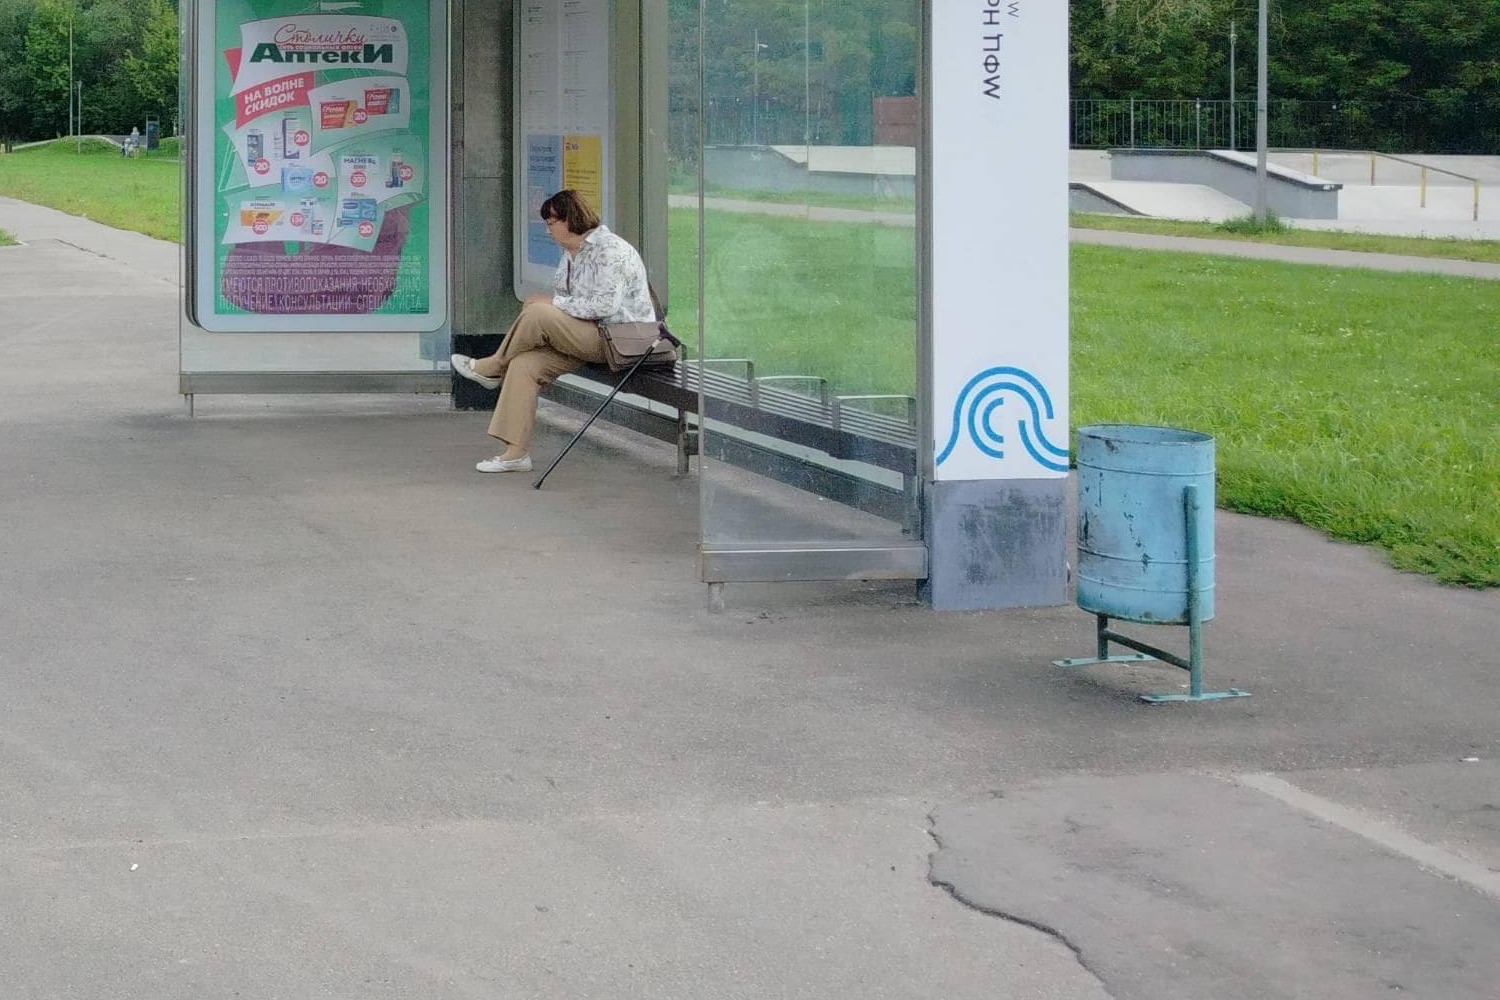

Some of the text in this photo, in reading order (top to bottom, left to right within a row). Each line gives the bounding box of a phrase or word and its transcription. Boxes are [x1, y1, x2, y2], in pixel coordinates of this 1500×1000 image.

[274, 23, 365, 45] Столички
[983, 33, 1003, 99] МФЦ
[244, 77, 305, 105] НА ВОЛНЕ
[244, 91, 295, 115] СКИДОК
[294, 134, 308, 143] 20
[256, 162, 269, 171] 20
[314, 175, 328, 184] 20
[360, 225, 373, 234] 20
